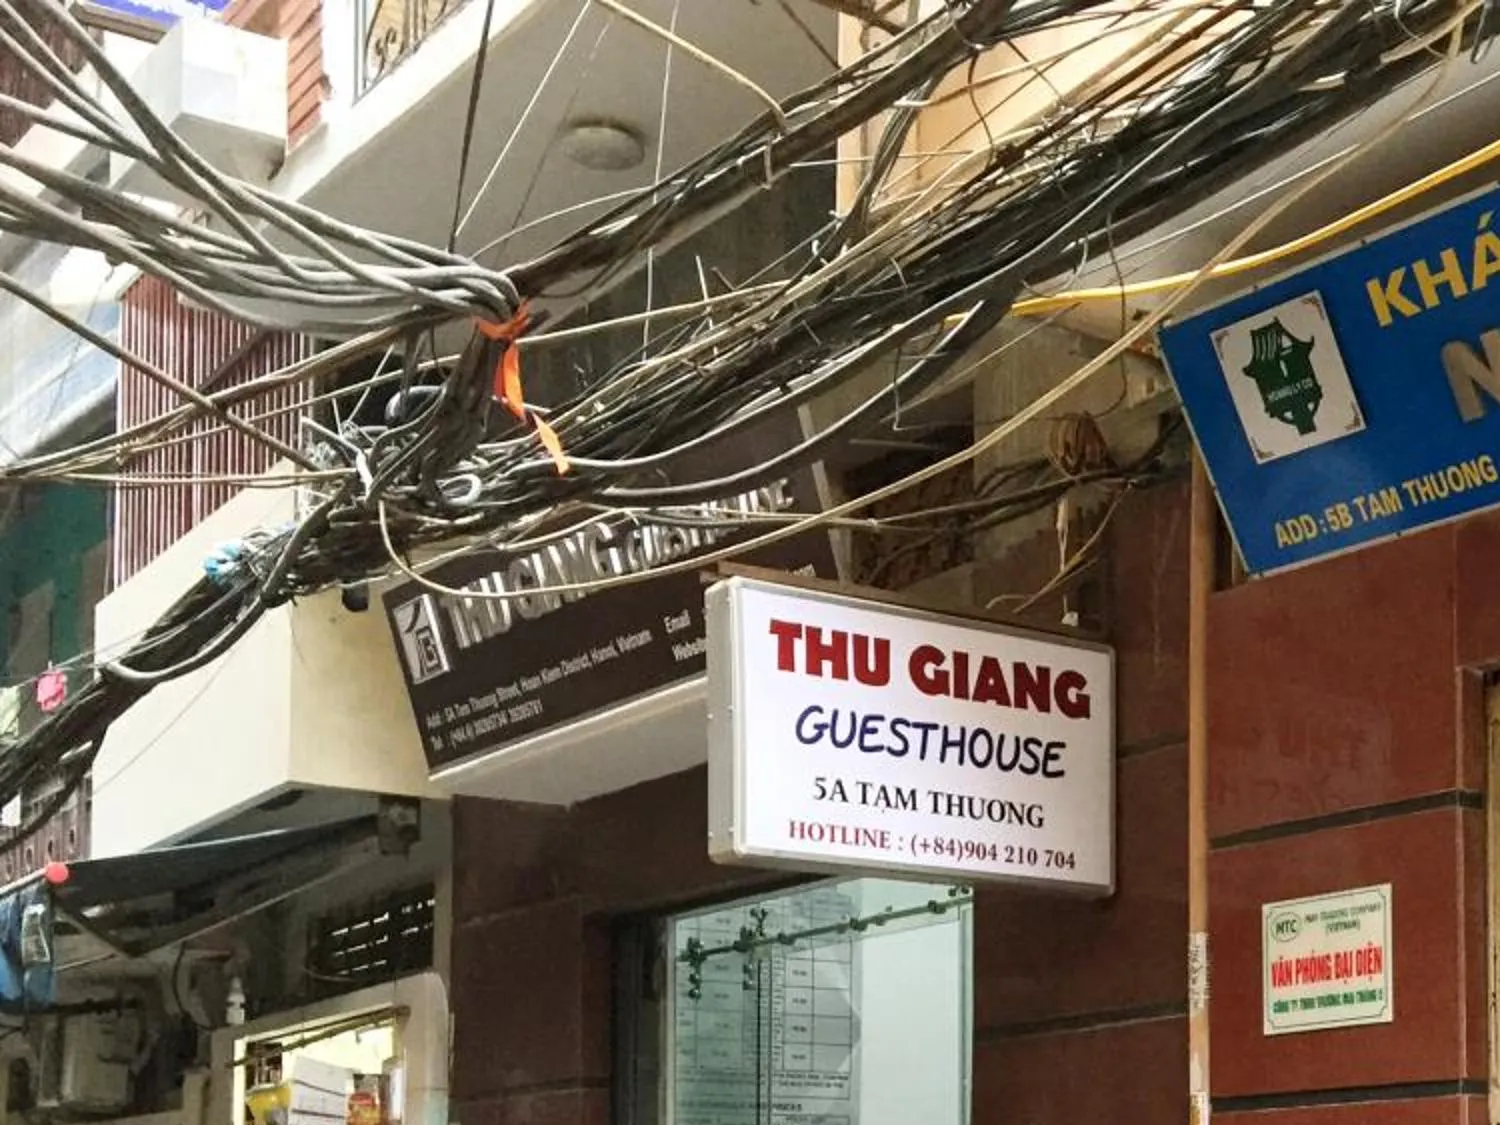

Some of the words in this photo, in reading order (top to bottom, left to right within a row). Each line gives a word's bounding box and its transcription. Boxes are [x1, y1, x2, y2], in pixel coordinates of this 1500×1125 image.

[1355, 487, 1403, 524] TAM
[1402, 454, 1499, 507] THUONG
[769, 618, 891, 687] THU
[909, 645, 1092, 720] GIANG
[795, 705, 1067, 778] GUESTHOUSE
[813, 776, 849, 803] 5A
[789, 820, 891, 850] HOTLINE
[910, 834, 997, 863] (+84)904
[1005, 845, 1038, 866] 210
[1044, 849, 1077, 870] 704
